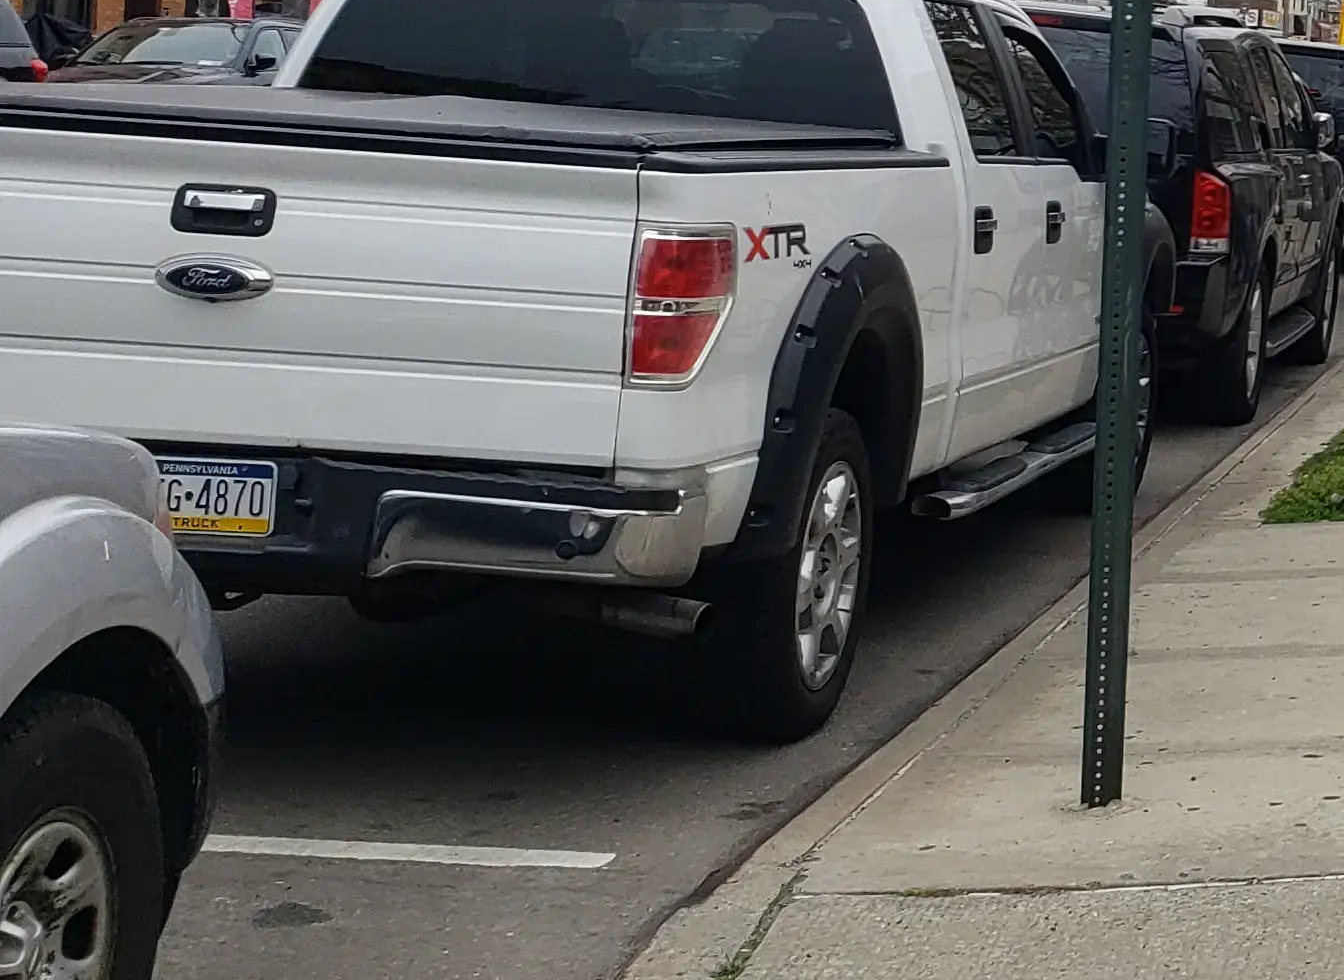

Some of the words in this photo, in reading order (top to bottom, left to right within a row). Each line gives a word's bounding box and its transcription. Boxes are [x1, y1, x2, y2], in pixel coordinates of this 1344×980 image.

[742, 222, 812, 263] XTR
[182, 267, 234, 288] Ford
[162, 463, 239, 476] PENNSYLVANIA
[172, 516, 220, 529] TRUCK
